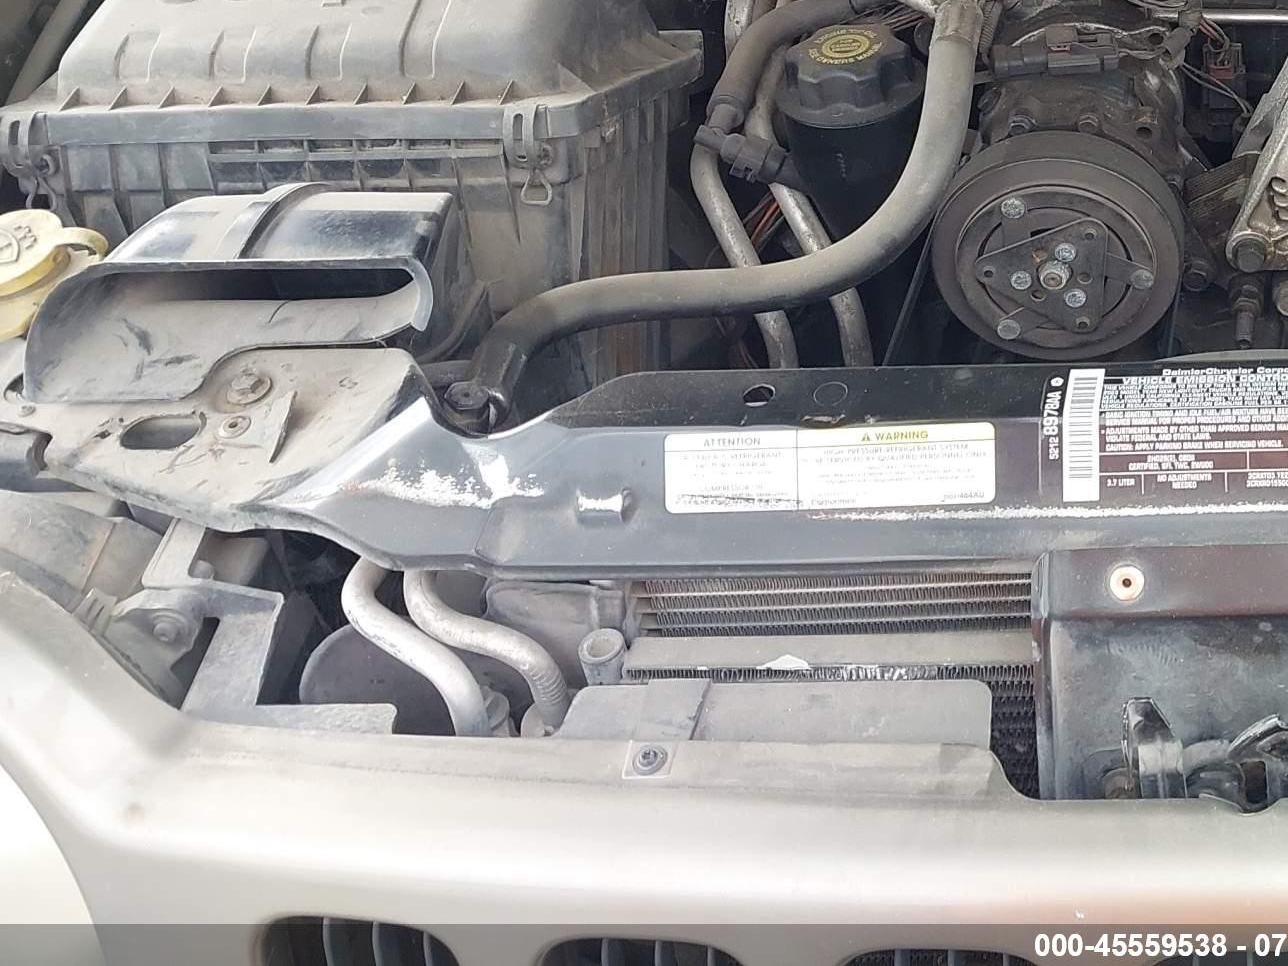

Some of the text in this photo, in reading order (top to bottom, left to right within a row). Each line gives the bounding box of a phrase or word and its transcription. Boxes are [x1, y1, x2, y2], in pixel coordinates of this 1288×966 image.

[1162, 367, 1254, 376] DaimlerChrysler
[1123, 376, 1171, 384] VEHICLE
[1176, 375, 1235, 384] EMISSION
[874, 431, 929, 442] WARNING
[704, 438, 761, 447] ATTENTION
